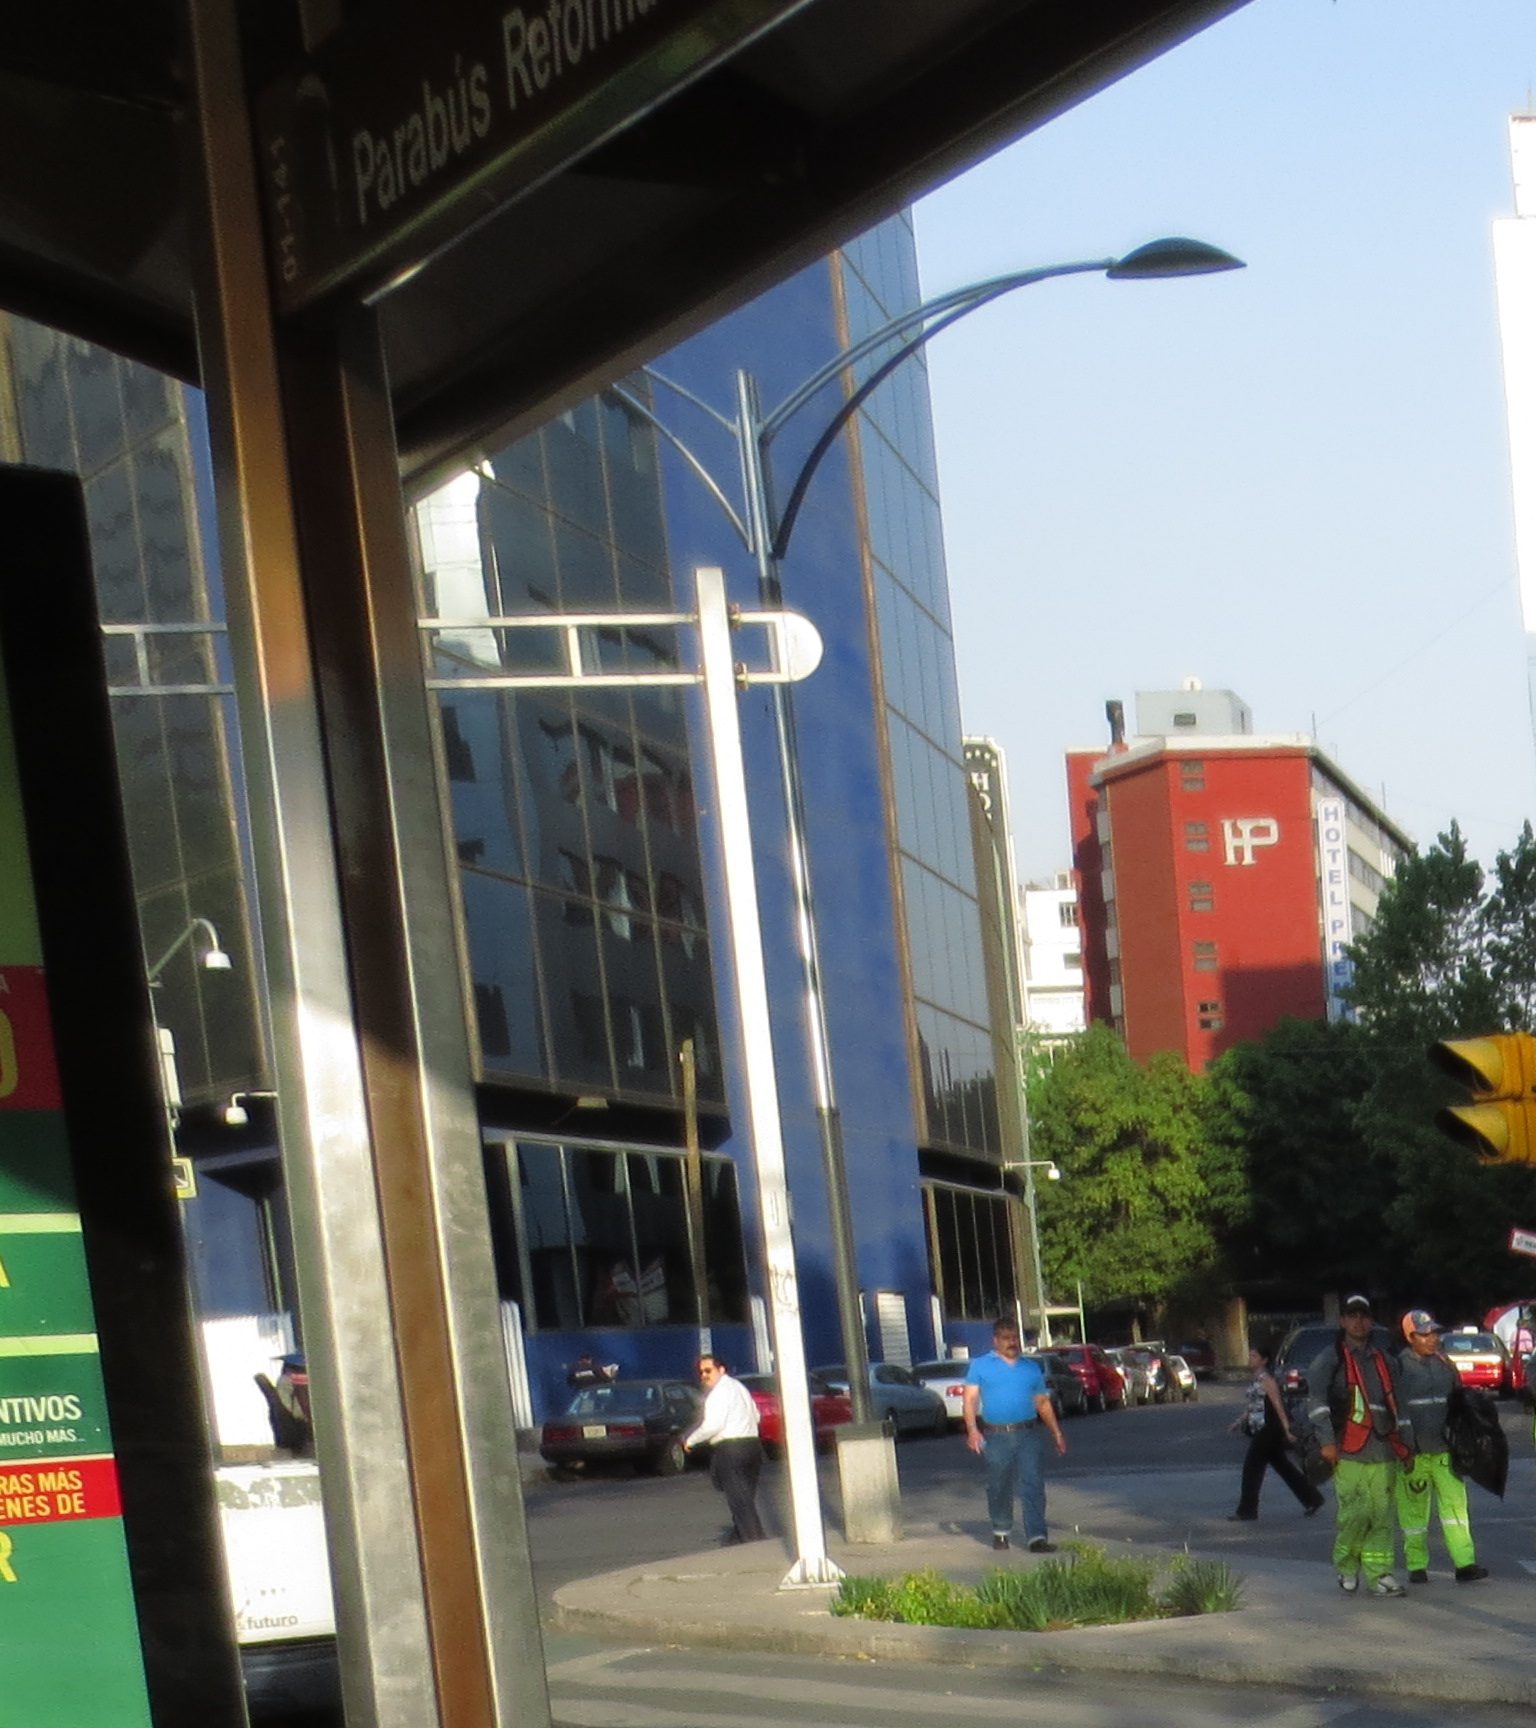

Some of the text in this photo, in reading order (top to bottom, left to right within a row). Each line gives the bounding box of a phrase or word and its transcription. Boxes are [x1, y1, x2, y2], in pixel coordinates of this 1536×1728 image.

[351, 52, 491, 226] Parabús
[1222, 817, 1280, 866] HP
[1324, 806, 1343, 906] HOTEL
[57, 1493, 86, 1515] DE
[247, 1615, 298, 1630] futuro
